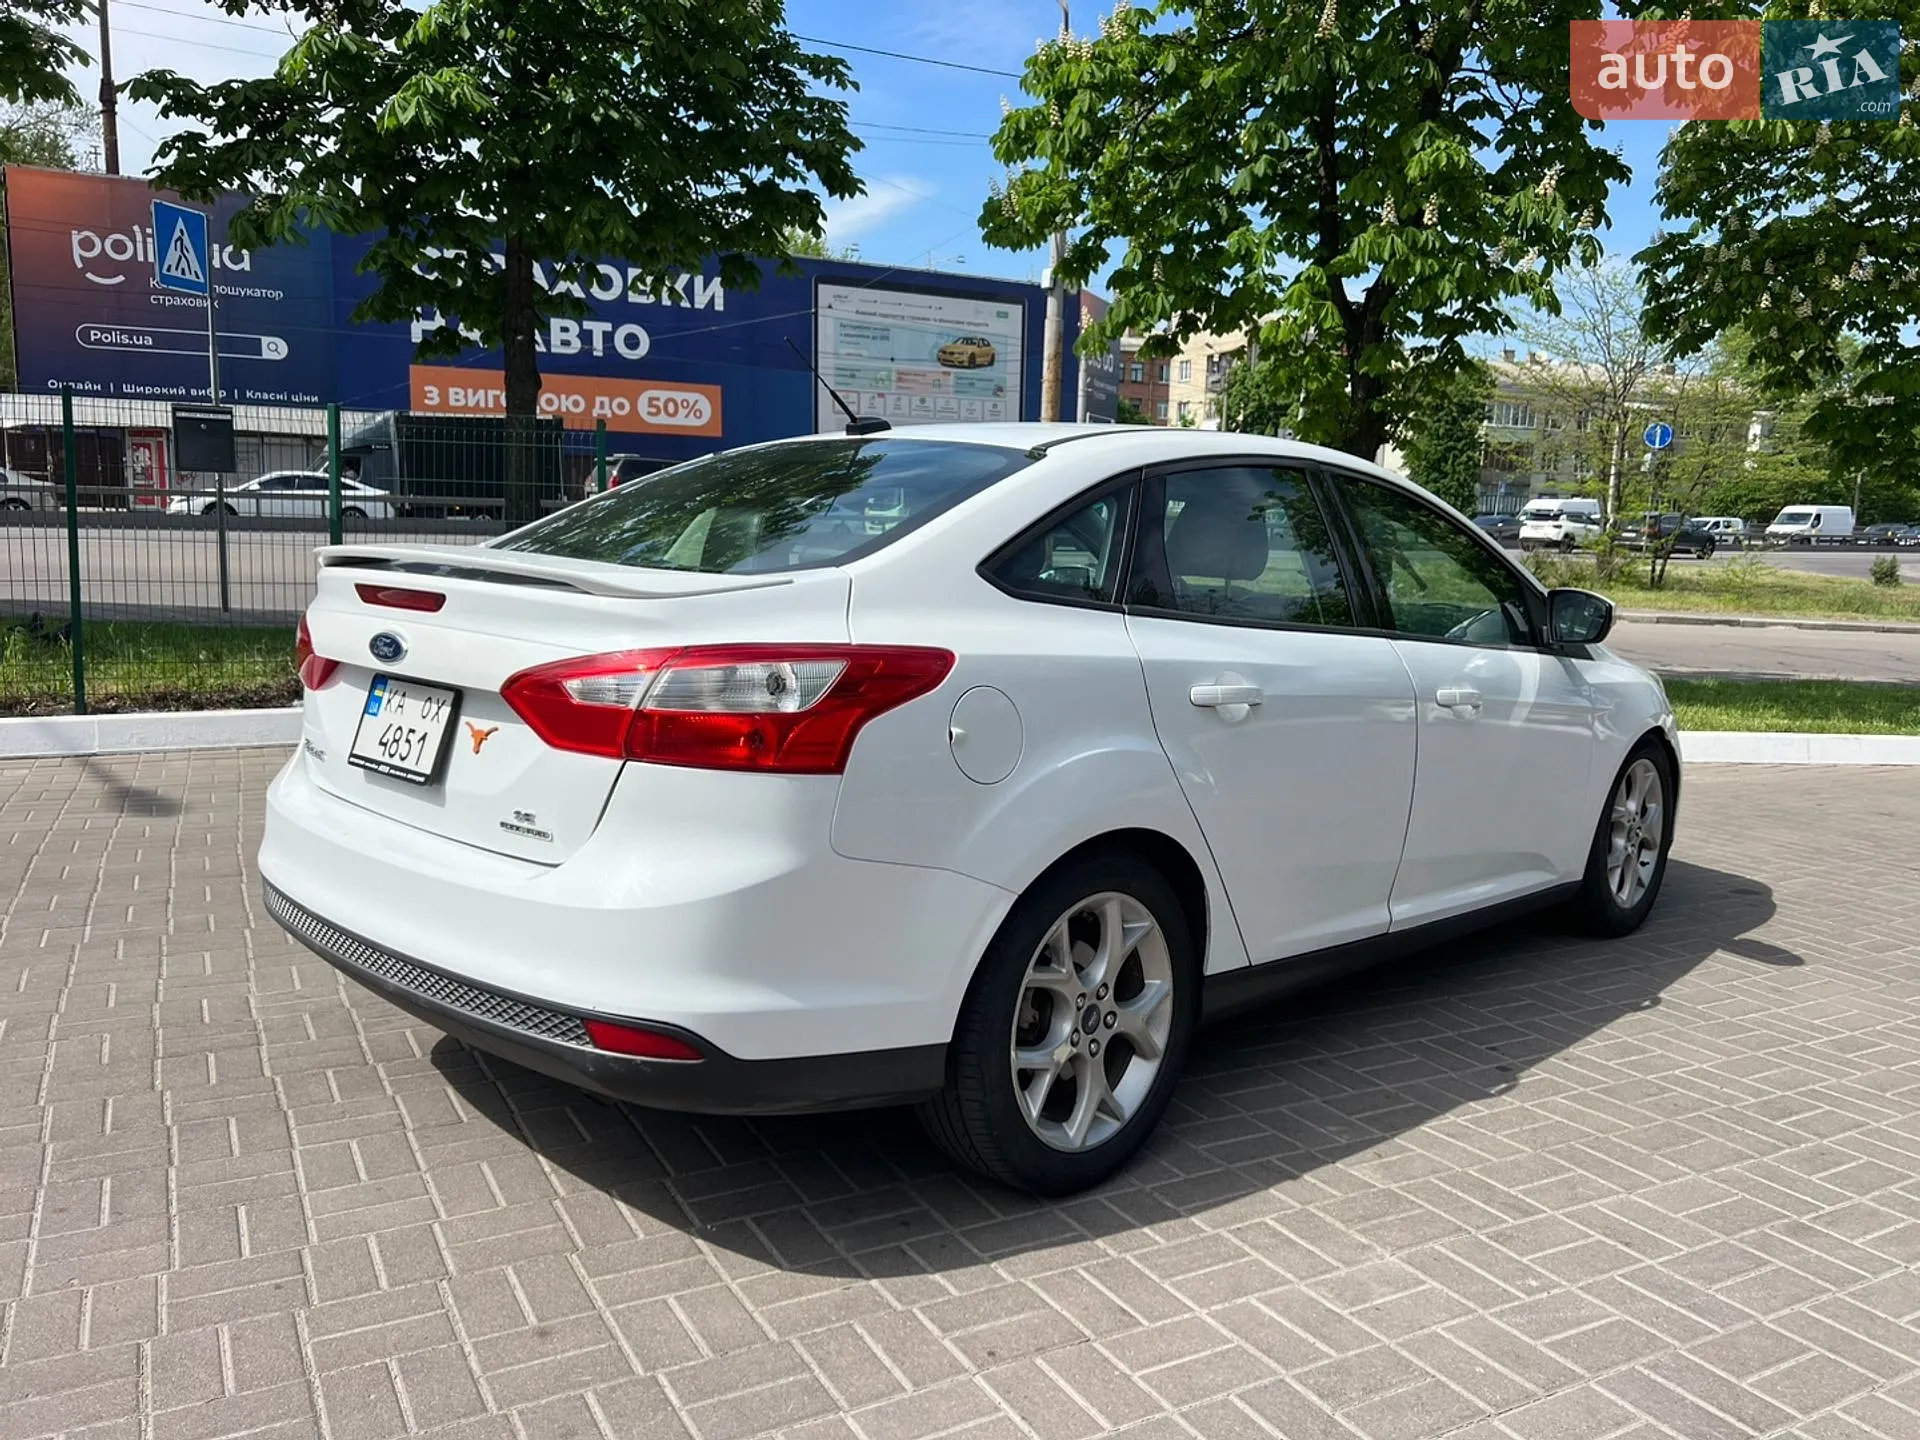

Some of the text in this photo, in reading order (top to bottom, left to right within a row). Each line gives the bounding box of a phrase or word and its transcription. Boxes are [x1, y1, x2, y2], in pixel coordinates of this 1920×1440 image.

[90, 329, 153, 346] Polis.ua
[122, 383, 186, 396] Широкий
[246, 389, 288, 401] Класні
[291, 392, 319, 403] ціни
[448, 387, 586, 414] ВИГОЮ
[592, 395, 632, 418] ДО
[645, 395, 704, 420] 50%
[378, 722, 428, 767] 4851
